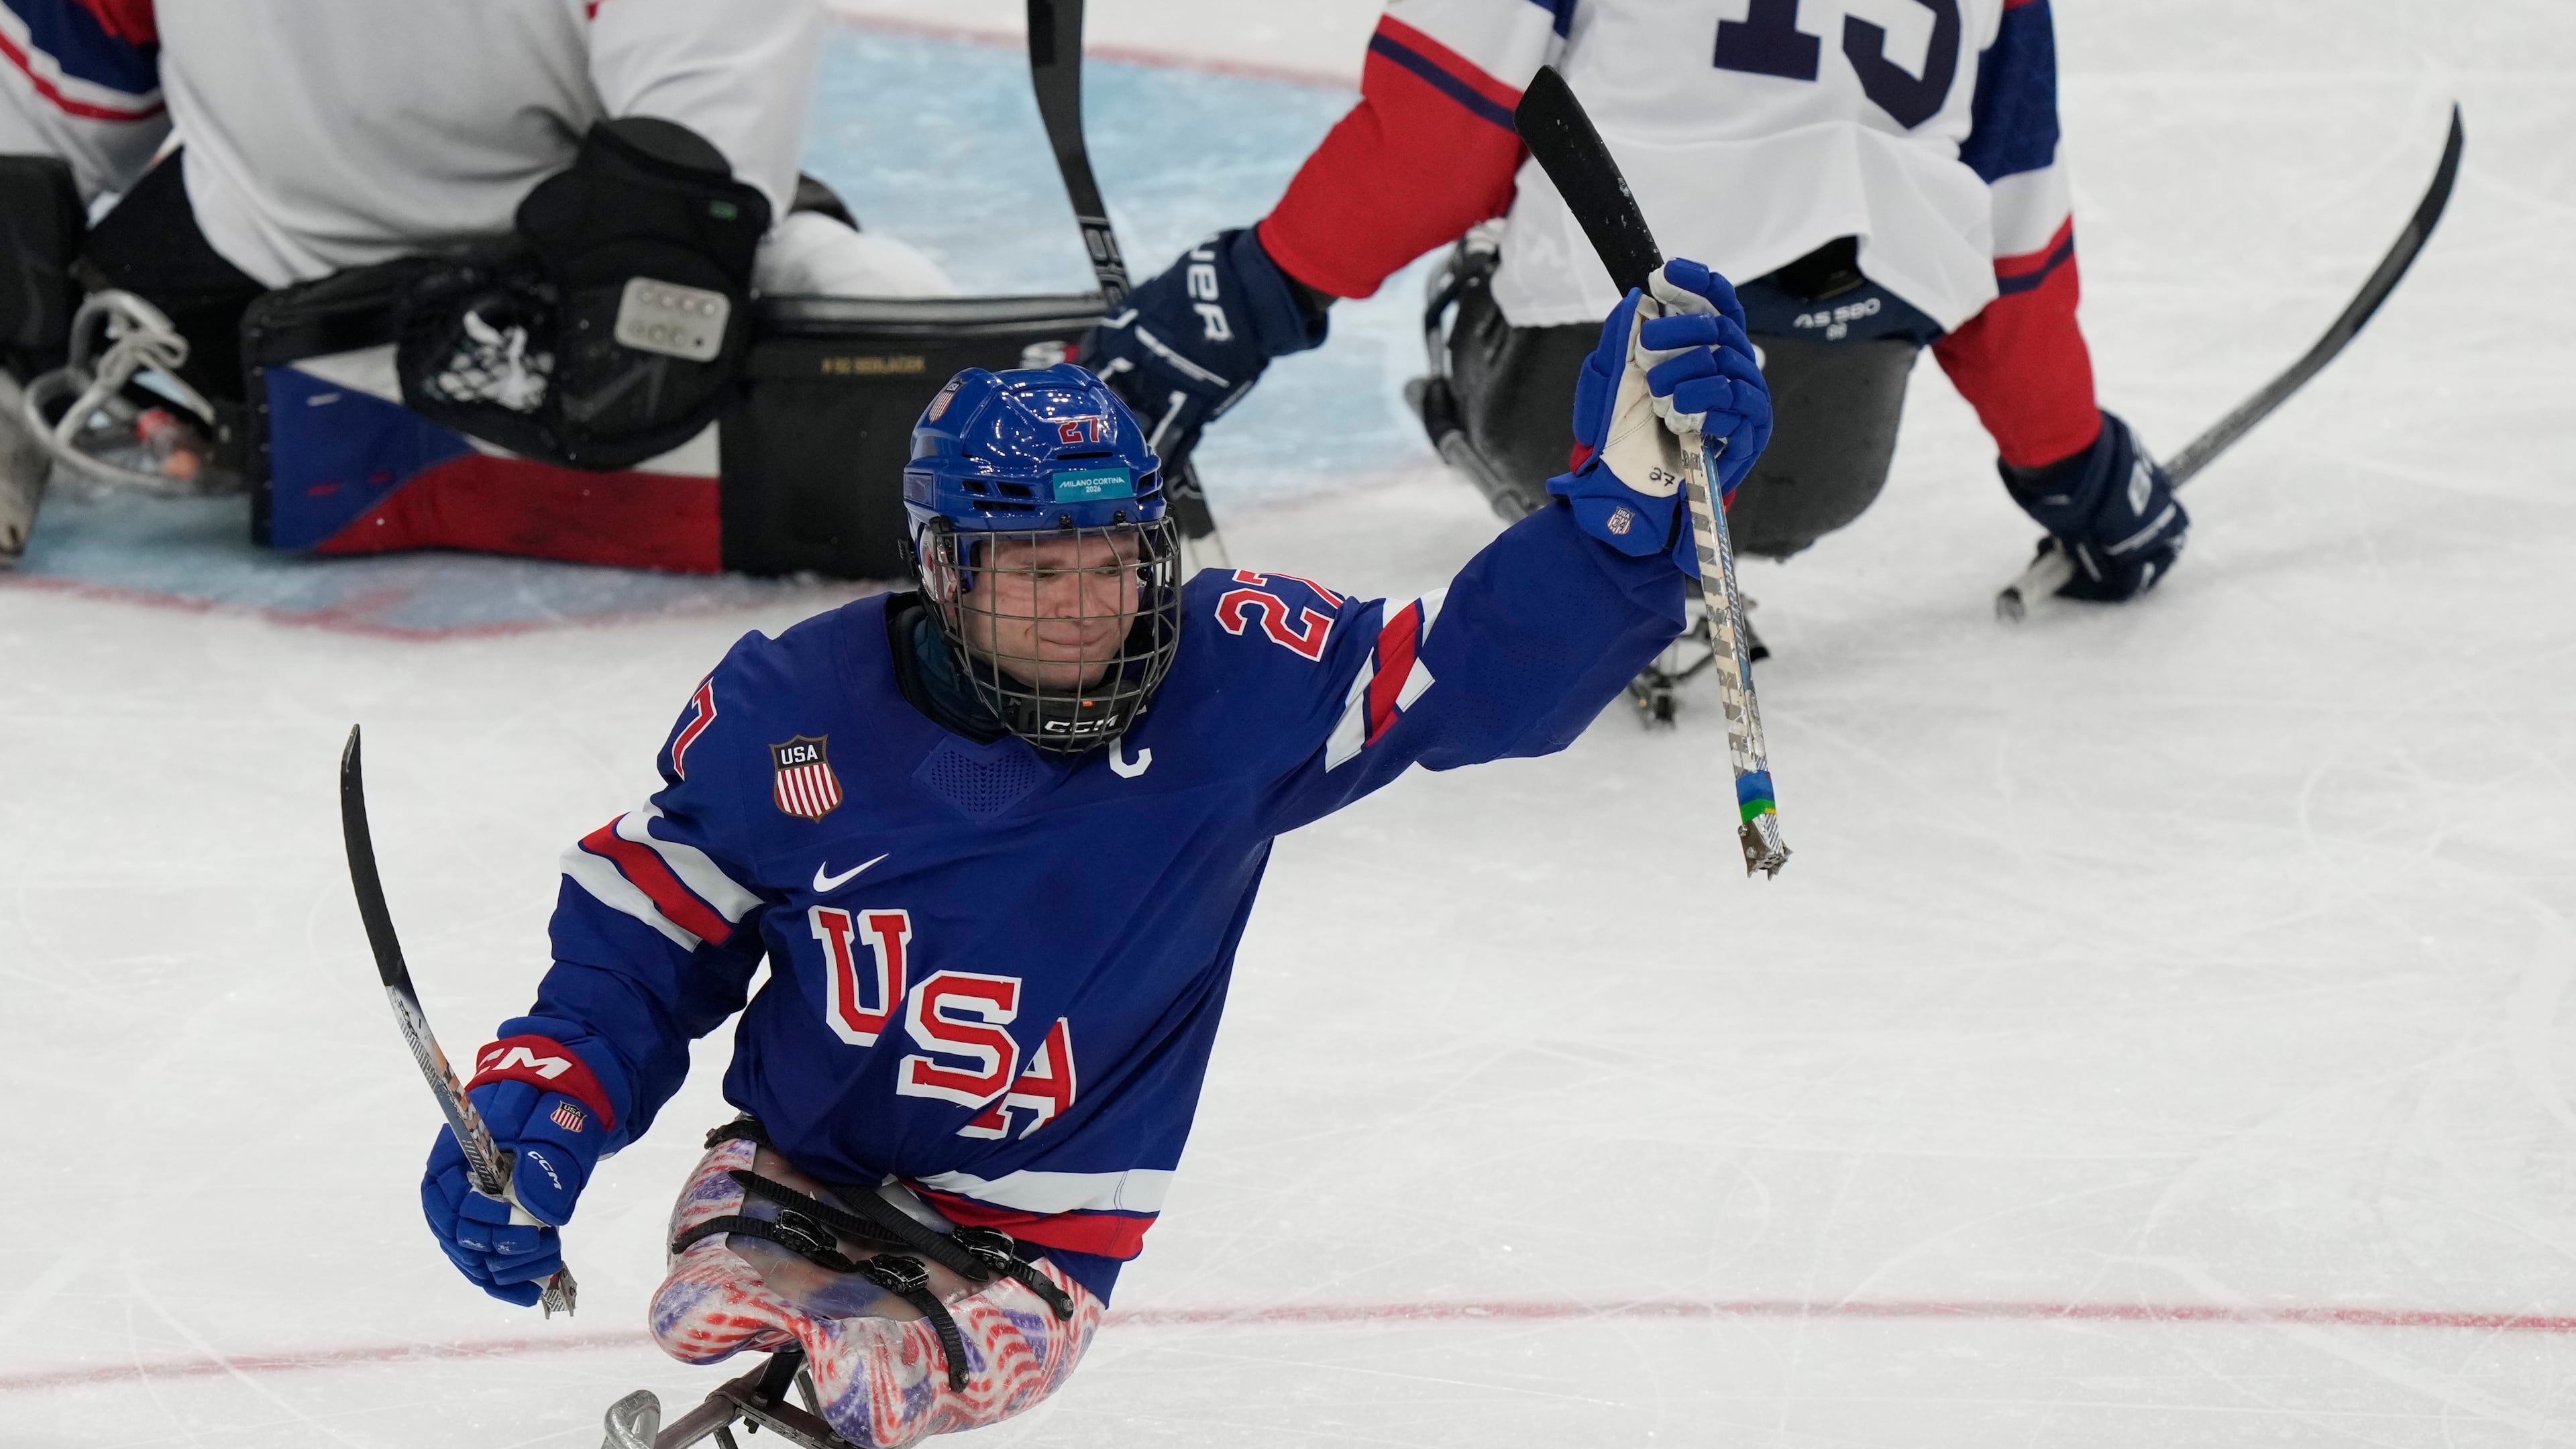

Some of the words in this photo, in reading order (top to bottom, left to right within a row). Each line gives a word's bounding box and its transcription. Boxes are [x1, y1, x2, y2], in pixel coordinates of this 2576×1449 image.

[1055, 415, 1100, 444] 27
[1059, 479, 1092, 488] MILANO
[1093, 477, 1125, 486] CORTINA
[1650, 467, 1675, 486] 27
[1617, 509, 1630, 519] USA
[672, 673, 717, 782] 7
[1044, 714, 1119, 733] CCM
[1109, 705, 1152, 779] C
[781, 745, 818, 765] USA
[808, 904, 1077, 1140] USA
[564, 1105, 581, 1117] USA
[527, 1150, 562, 1190] CCM
